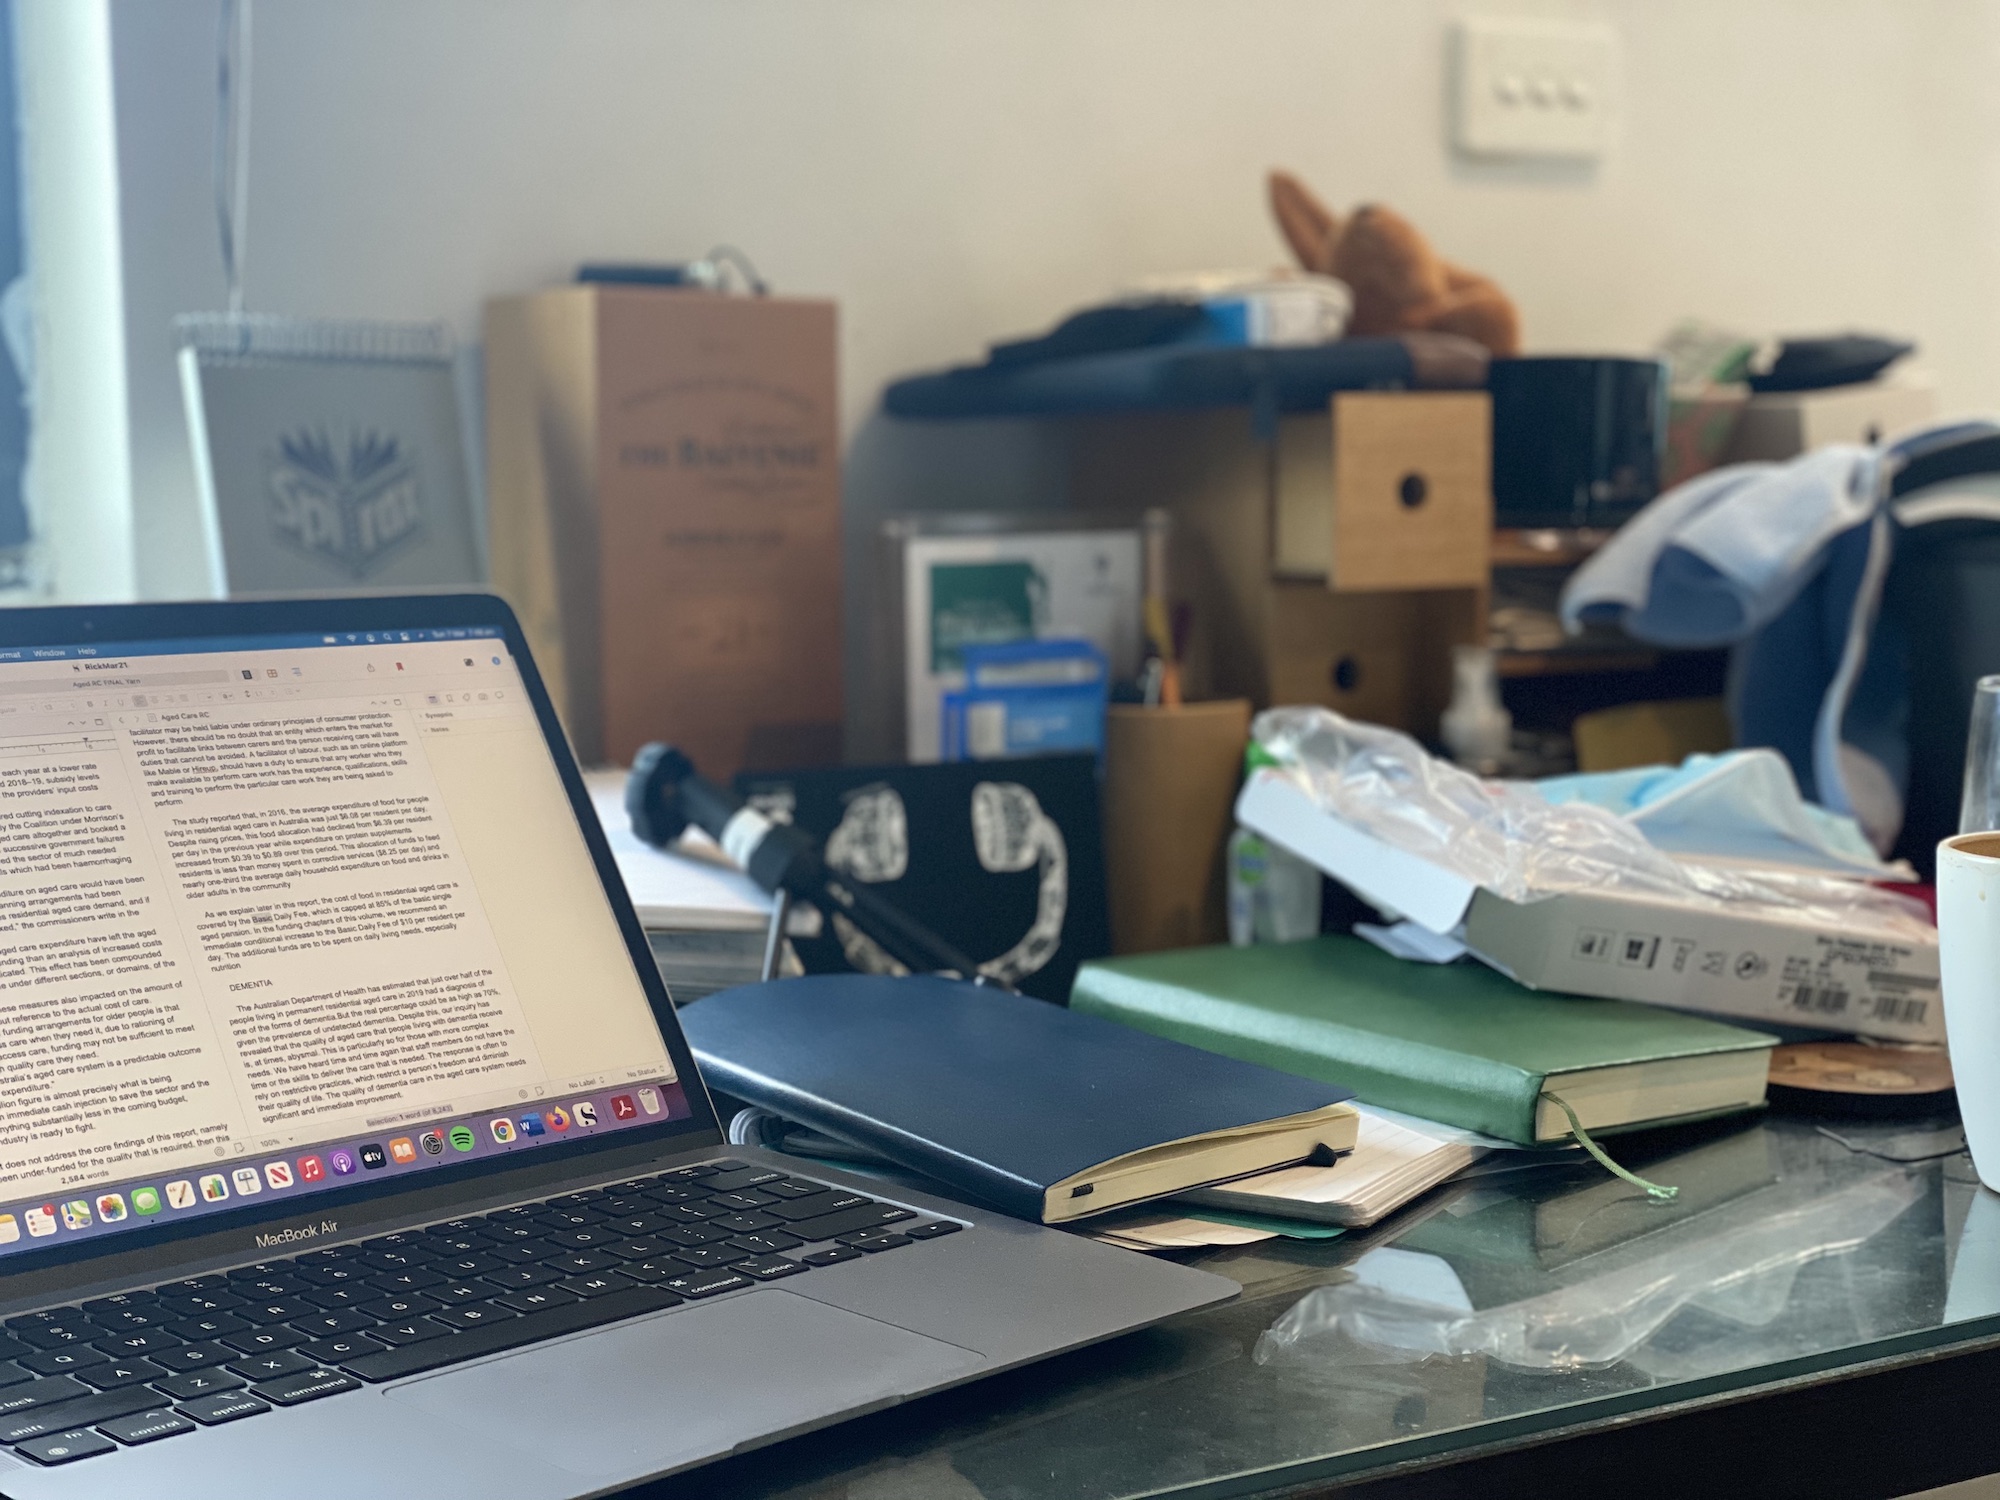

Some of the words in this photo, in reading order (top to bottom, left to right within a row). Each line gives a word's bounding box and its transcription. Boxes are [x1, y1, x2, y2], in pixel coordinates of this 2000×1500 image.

[33, 649, 66, 657] Window
[77, 647, 97, 656] Help
[84, 661, 129, 671] RickMar21
[161, 713, 180, 722] Aged
[180, 712, 198, 720] Care
[198, 711, 210, 719] RC
[155, 799, 184, 809] perform
[332, 801, 371, 811] expenditure
[43, 806, 84, 816] indexation
[23, 819, 58, 828] Coalition
[194, 824, 232, 834] residential
[32, 829, 72, 839] altogether
[277, 827, 310, 836] allocation
[293, 835, 334, 846] expenditure
[370, 826, 412, 837] supplements
[2, 842, 47, 853] successive
[48, 836, 95, 850] government
[72, 855, 132, 867] haemorrhaging
[311, 854, 345, 863] corrective
[302, 864, 340, 874] household
[340, 861, 380, 871] expenditure
[252, 881, 292, 891] community
[27, 893, 83, 906] arrangements
[229, 906, 255, 915] explain
[383, 886, 418, 896] residential
[8, 907, 50, 919] residential
[304, 918, 335, 927] chapters
[398, 904, 437, 915] recommend
[36, 915, 96, 927] commissioners
[197, 920, 227, 930] covered
[39, 938, 86, 950] expenditure
[241, 945, 277, 956] additional
[425, 922, 458, 932] especially
[244, 934, 283, 946] conditional
[58, 948, 91, 958] analysis
[102, 940, 140, 952] increased
[111, 949, 162, 962] compounded
[211, 963, 242, 972] nutrition
[34, 973, 68, 984] different
[229, 978, 274, 991] DEMENTIA
[18, 999, 59, 1010] measures
[79, 989, 116, 1002] impacted
[253, 999, 290, 1009] Australian
[290, 991, 334, 1004] Department
[325, 998, 362, 1010] residential
[378, 1002, 418, 1014] percentage
[11, 1012, 51, 1022] reference
[131, 1018, 166, 1028] rationing
[35, 1016, 91, 1031] arrangements
[129, 1028, 164, 1040] sufficient
[240, 1045, 272, 1057] revealed
[446, 1013, 478, 1023] dementia
[272, 1030, 312, 1042] prevalence
[322, 1020, 362, 1032] undetected
[346, 1038, 385, 1052] particularly
[443, 1046, 474, 1056] response
[123, 1051, 166, 1066] predictable
[626, 1071, 636, 1079] No
[636, 1066, 657, 1077] Status
[82, 1083, 119, 1097] precisely
[281, 1084, 318, 1095] restrictive
[375, 1079, 408, 1090] dementia
[568, 1082, 577, 1090] No
[578, 1078, 596, 1088] Label
[5, 1106, 50, 1119] immediate
[73, 1097, 108, 1108] injection
[31, 1112, 84, 1127] substantially
[262, 1109, 300, 1122] significant
[404, 1111, 422, 1120] word
[113, 1138, 145, 1149] findings
[86, 1169, 109, 1179] words
[833, 1197, 862, 1207] return
[882, 1209, 905, 1219] shift
[255, 1224, 319, 1248] MacBook
[321, 1219, 338, 1235] Air
[761, 1263, 795, 1275] option
[691, 1276, 742, 1294] command
[283, 1378, 348, 1398] command
[4, 1397, 36, 1408] lock
[212, 1401, 256, 1417] option
[10, 1424, 45, 1437] shift
[130, 1420, 180, 1437] control
[64, 1431, 82, 1439] fn
